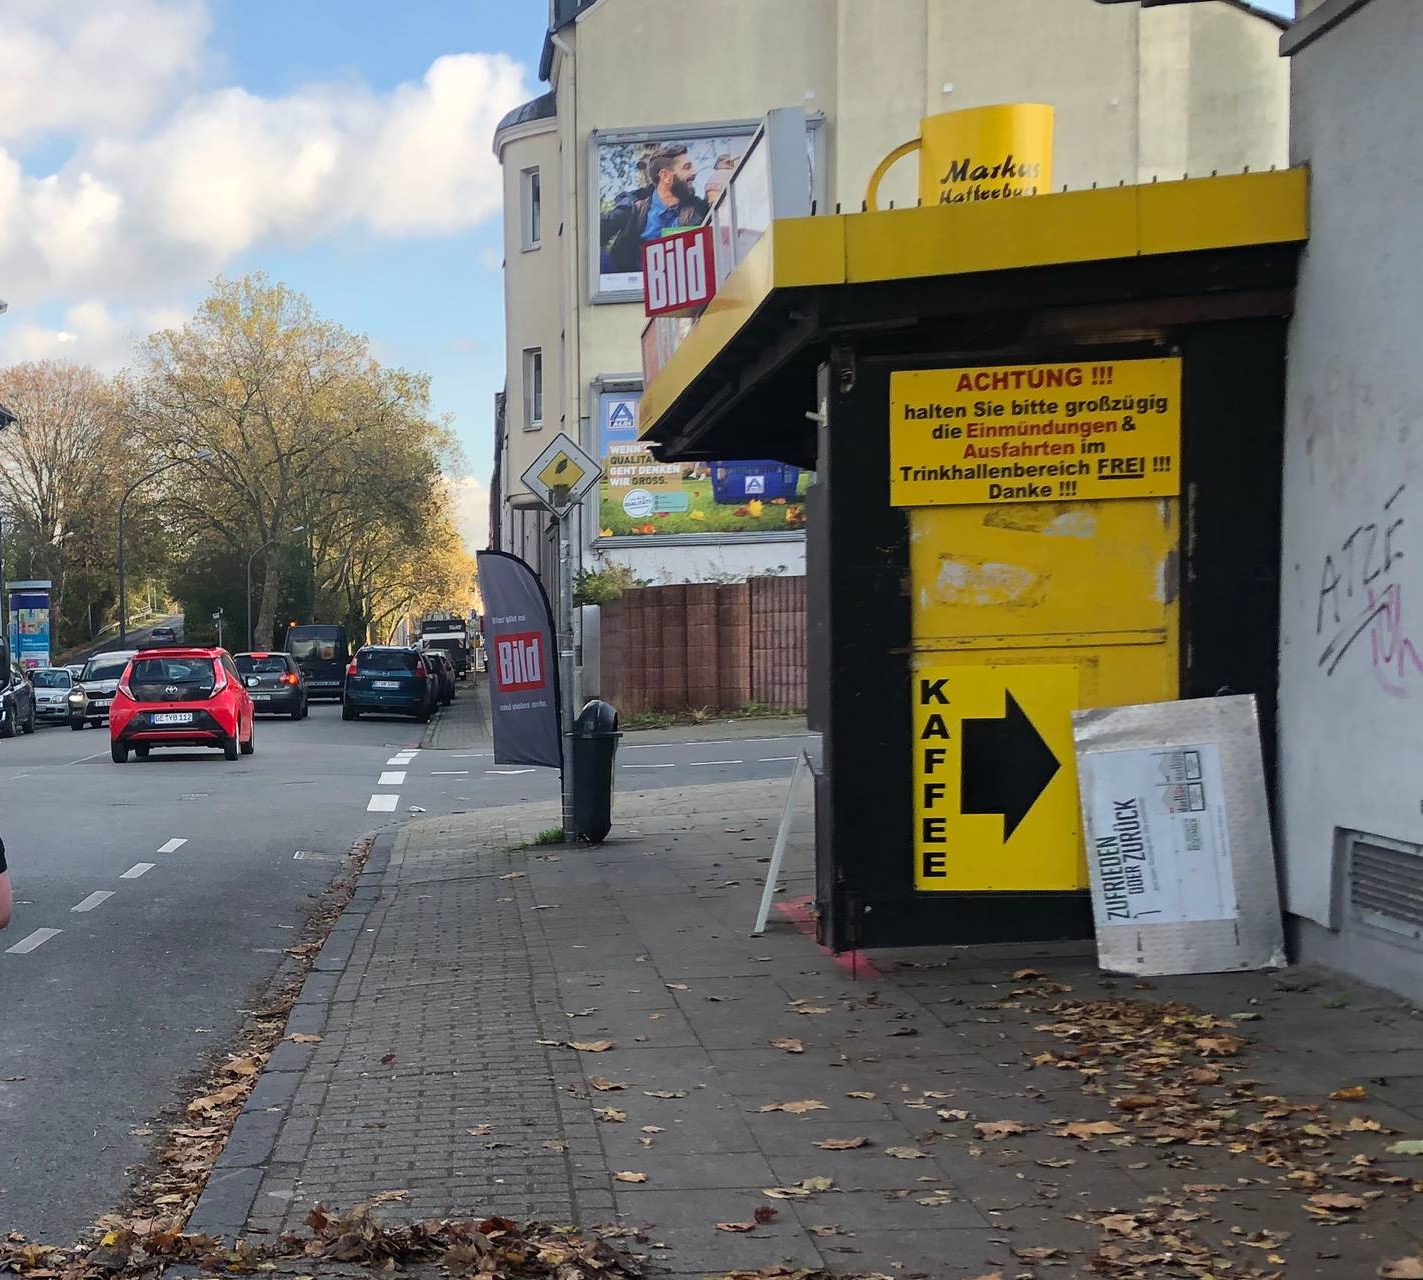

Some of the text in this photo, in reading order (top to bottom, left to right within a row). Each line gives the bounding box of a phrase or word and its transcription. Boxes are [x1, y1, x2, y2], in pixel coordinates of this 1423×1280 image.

[940, 154, 1040, 184] Markus
[646, 233, 706, 310] Bild
[955, 366, 1114, 392] ACHTUNG !!!
[904, 394, 1168, 421] halten Sie bitte großzügig
[932, 416, 1137, 440] die Einmündungen &
[963, 438, 1106, 460] Ausfahrten im
[609, 477, 630, 486] WIR
[610, 464, 681, 475] GEHT DENKEN
[899, 456, 1171, 482] Trinkhallenbereich FREI !!!
[988, 480, 1078, 500] Danke !!!
[498, 638, 541, 685] Bild
[920, 678, 950, 878] KAFFEE
[1113, 798, 1146, 894] ODER ZURÜCK
[1097, 836, 1130, 920] ZUFRIEDEN
